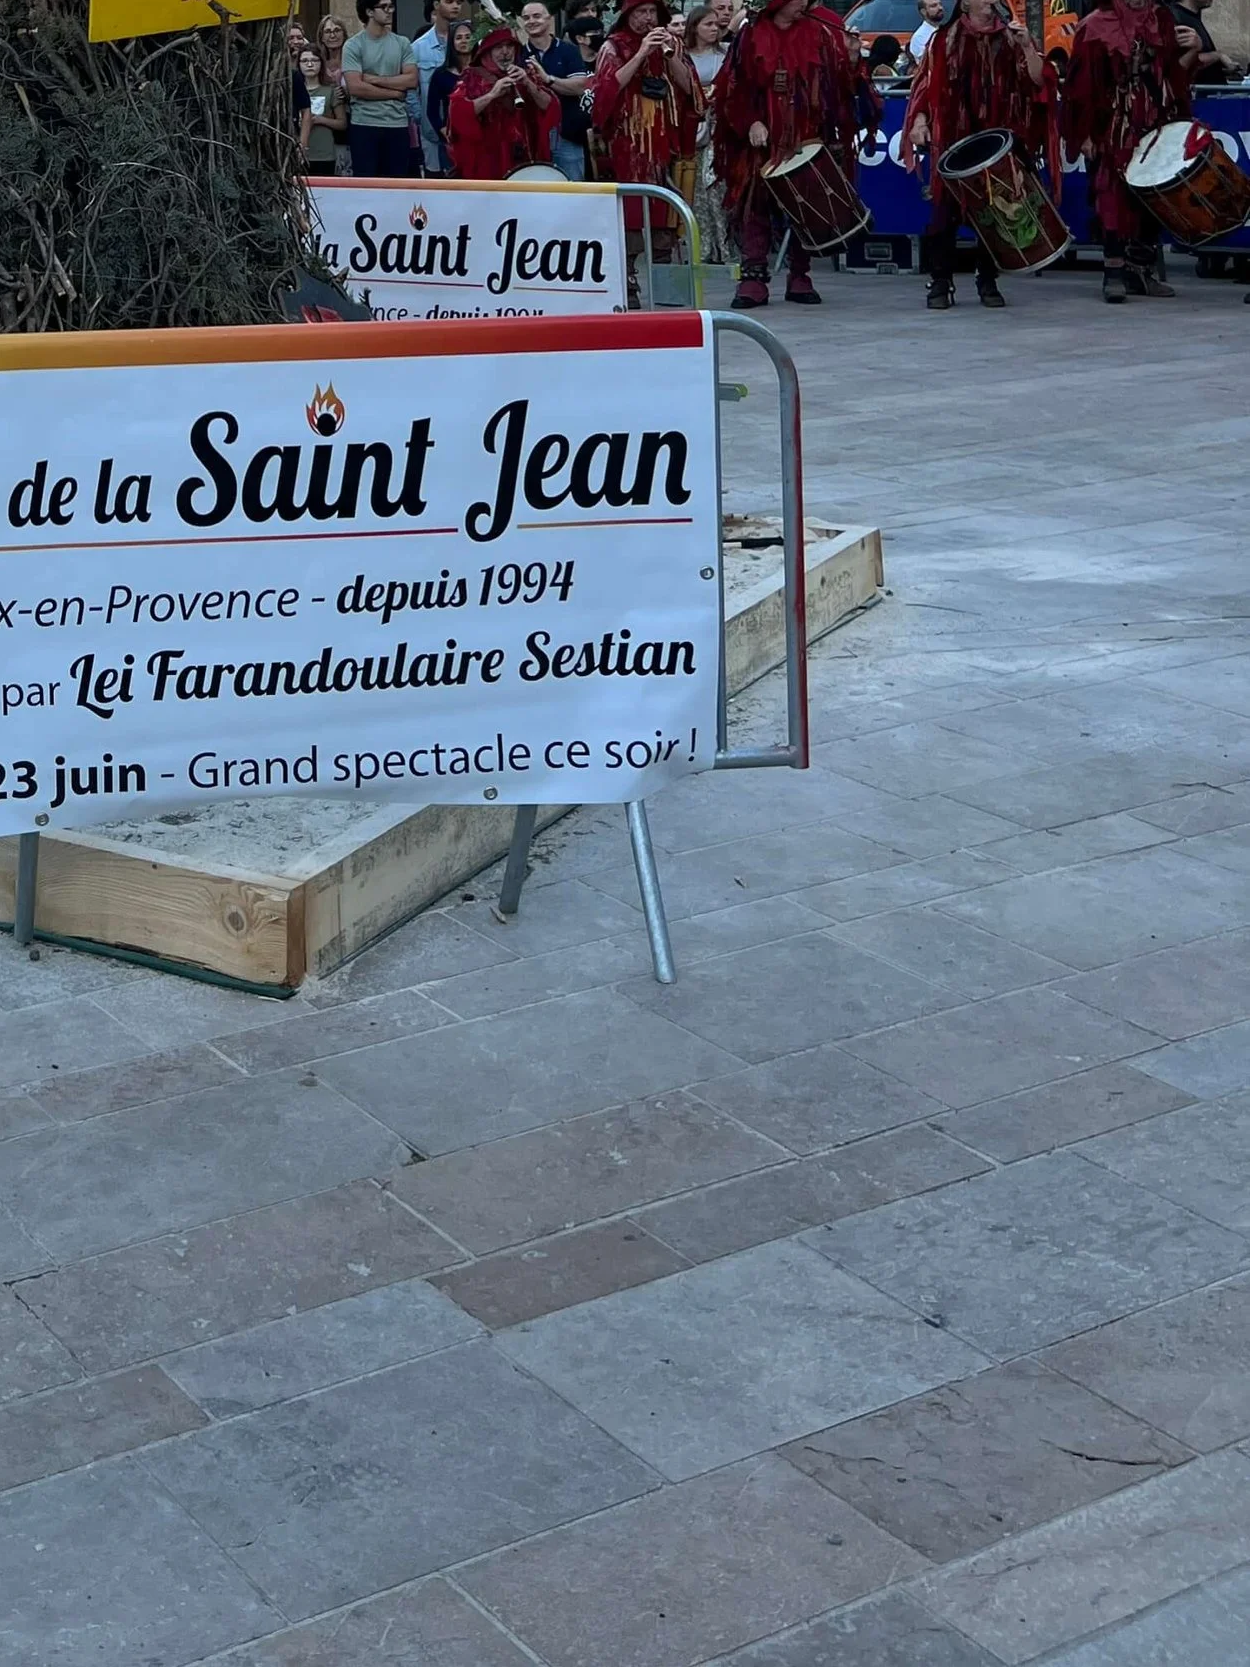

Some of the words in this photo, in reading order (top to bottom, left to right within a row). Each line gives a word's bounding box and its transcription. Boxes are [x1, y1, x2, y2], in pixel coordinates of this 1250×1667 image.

[349, 213, 472, 277] Saint
[486, 218, 606, 295] Jean
[7, 458, 78, 529] de
[92, 457, 152, 525] la
[175, 411, 436, 529] Saint
[464, 399, 692, 544] Jean
[335, 569, 468, 626] depuis
[477, 560, 576, 607] 1994
[2, 681, 62, 717] par
[69, 652, 136, 721] Lei
[146, 637, 506, 704] Farandoulaire
[518, 627, 698, 684] Sestian
[49, 753, 146, 809] juin
[188, 744, 318, 790] Grand
[334, 733, 532, 792] spectacle
[543, 740, 591, 770] ce
